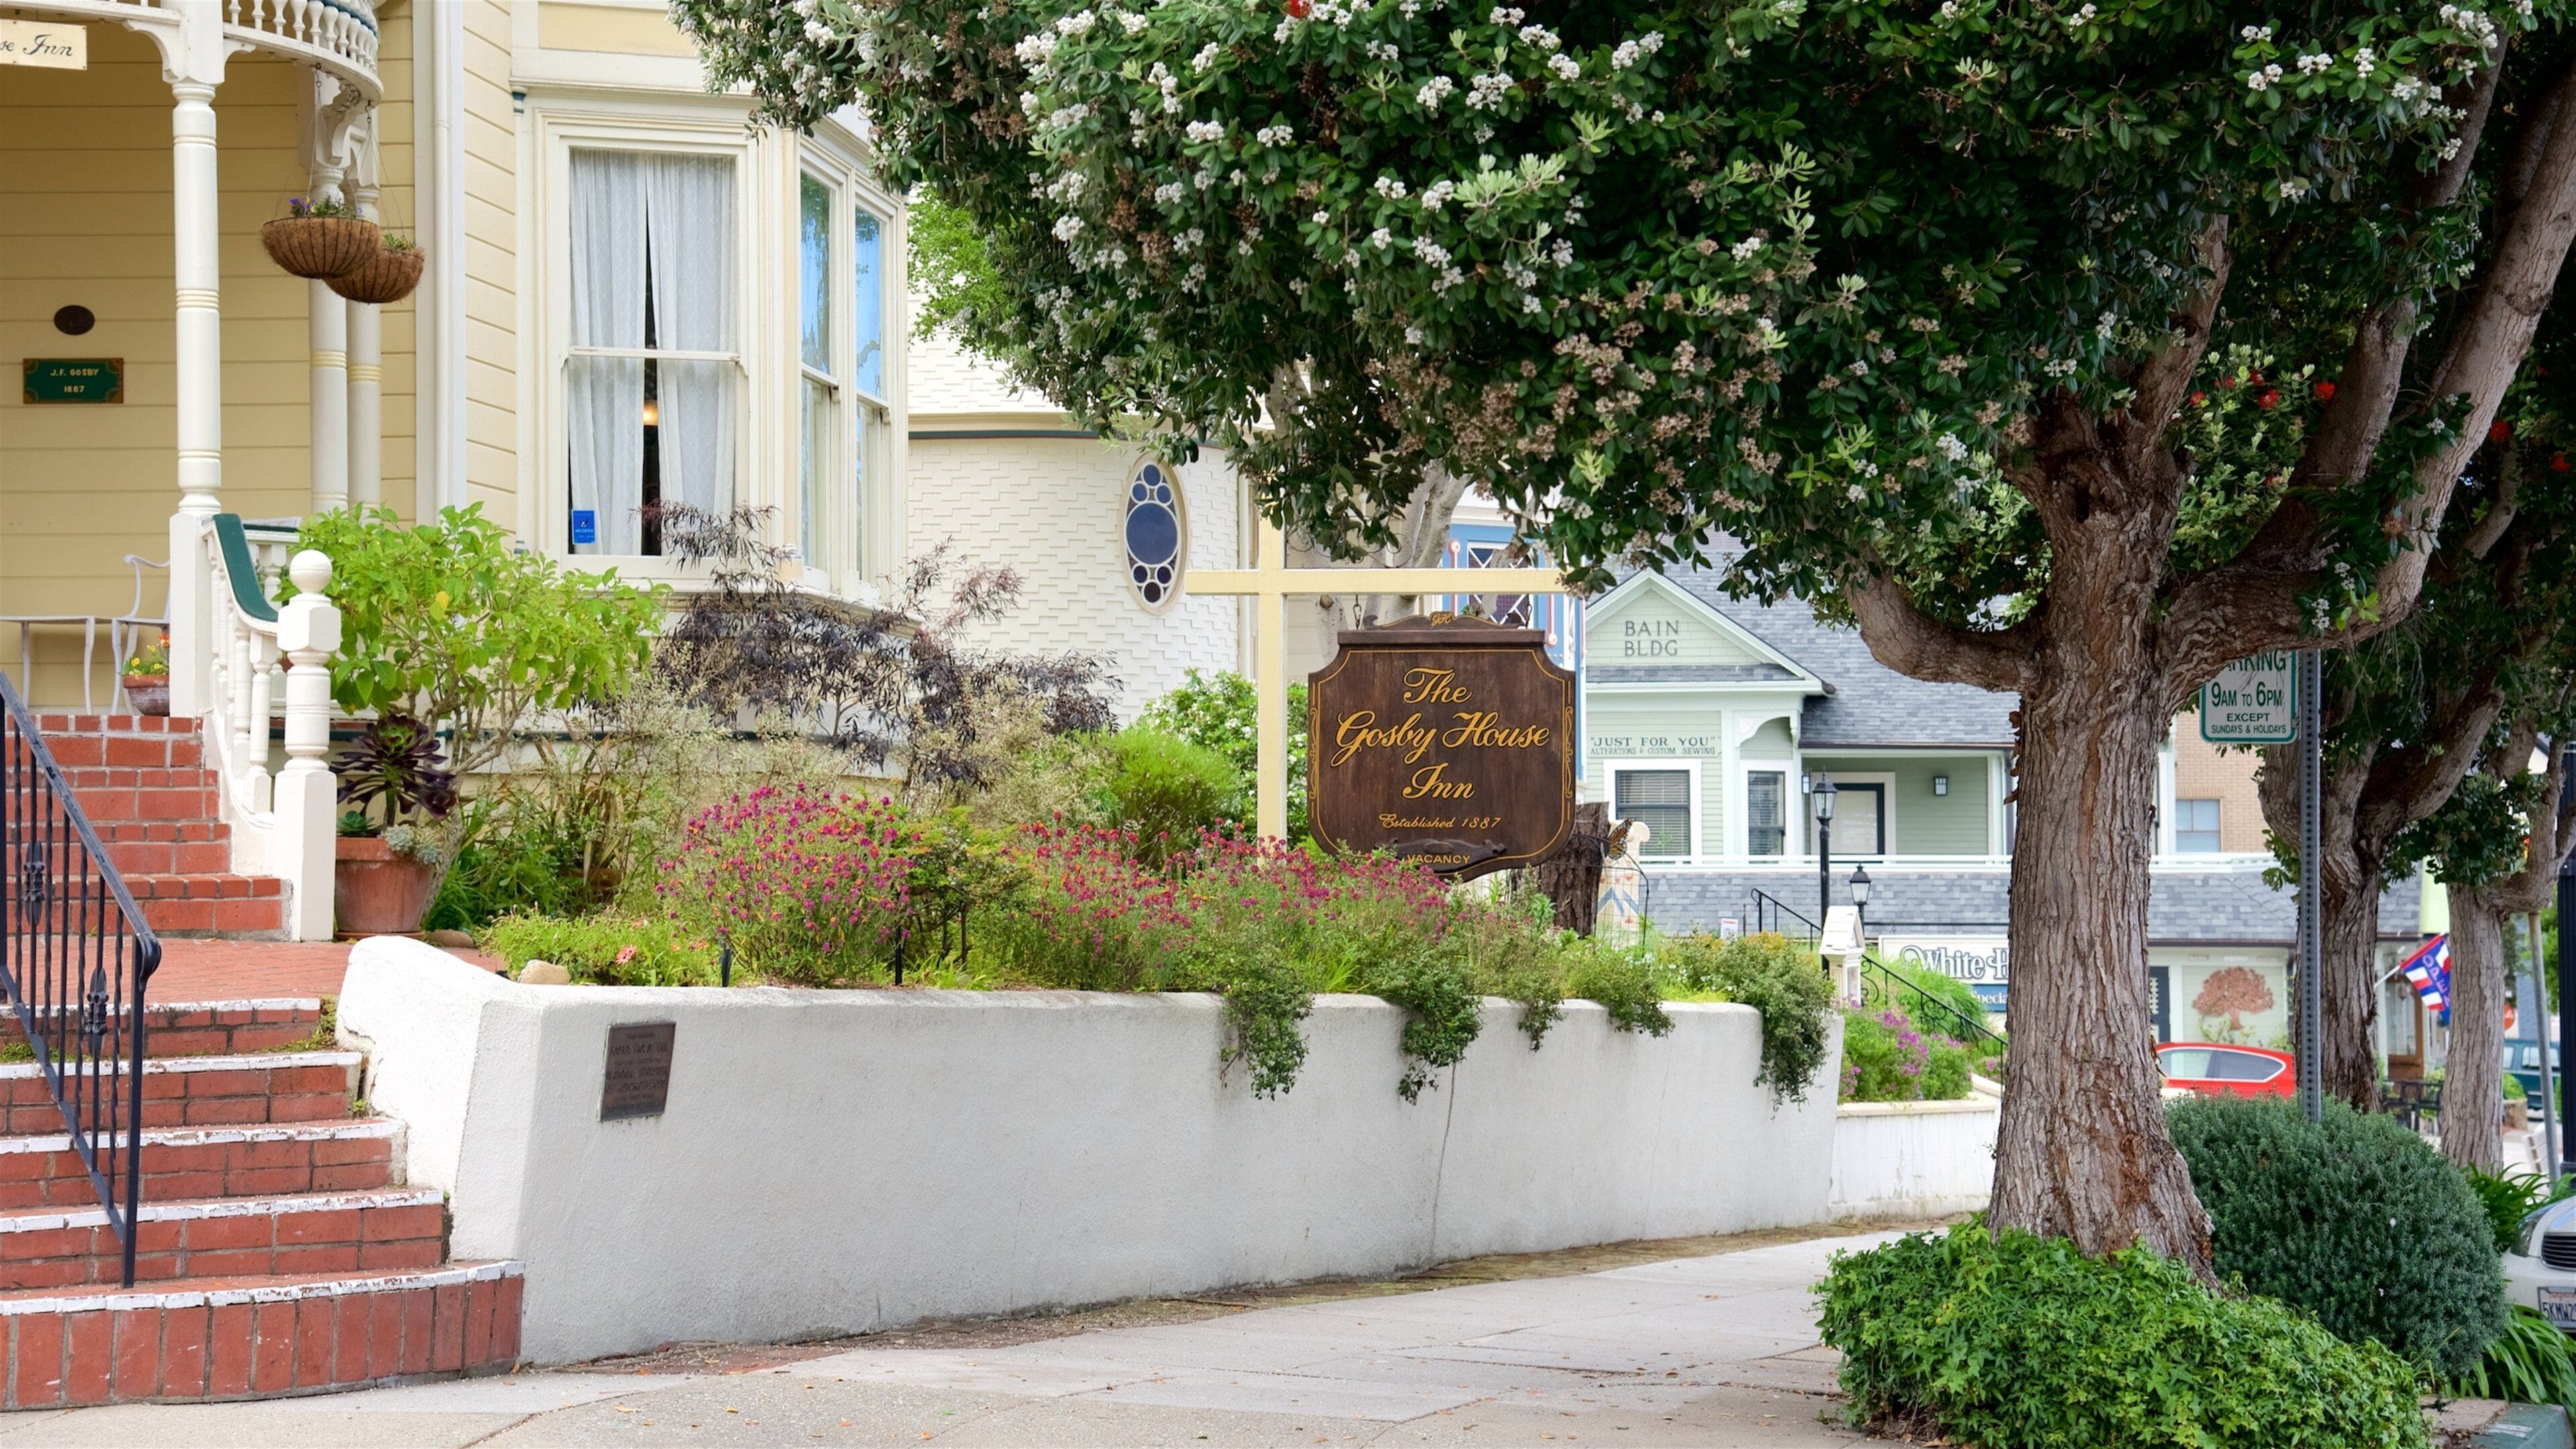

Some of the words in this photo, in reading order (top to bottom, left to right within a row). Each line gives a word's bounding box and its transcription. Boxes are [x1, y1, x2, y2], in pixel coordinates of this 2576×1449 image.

[23, 34, 73, 56] Inn
[70, 368, 99, 376] GOSBY
[64, 385, 85, 393] 1887
[1625, 620, 1678, 637] BAIN
[1624, 639, 1678, 657] BLDG
[1402, 666, 1474, 704] The
[2211, 682, 2237, 707] 9AM
[2242, 694, 2253, 706] TO
[2256, 681, 2283, 707] 6PM
[2226, 713, 2270, 722] EXCEPT
[2211, 725, 2243, 734] SUNDAYS
[2246, 725, 2251, 733] &
[2253, 724, 2286, 734] HOLIDAYS
[1330, 710, 1438, 768] Gosby
[1441, 710, 1552, 749] House
[1640, 737, 1669, 747] FOR
[1401, 761, 1476, 800] Inn
[1379, 813, 1456, 830] Established
[1461, 817, 1502, 829] 1887
[1407, 853, 1471, 865] VACANCY
[1900, 945, 1986, 979] White
